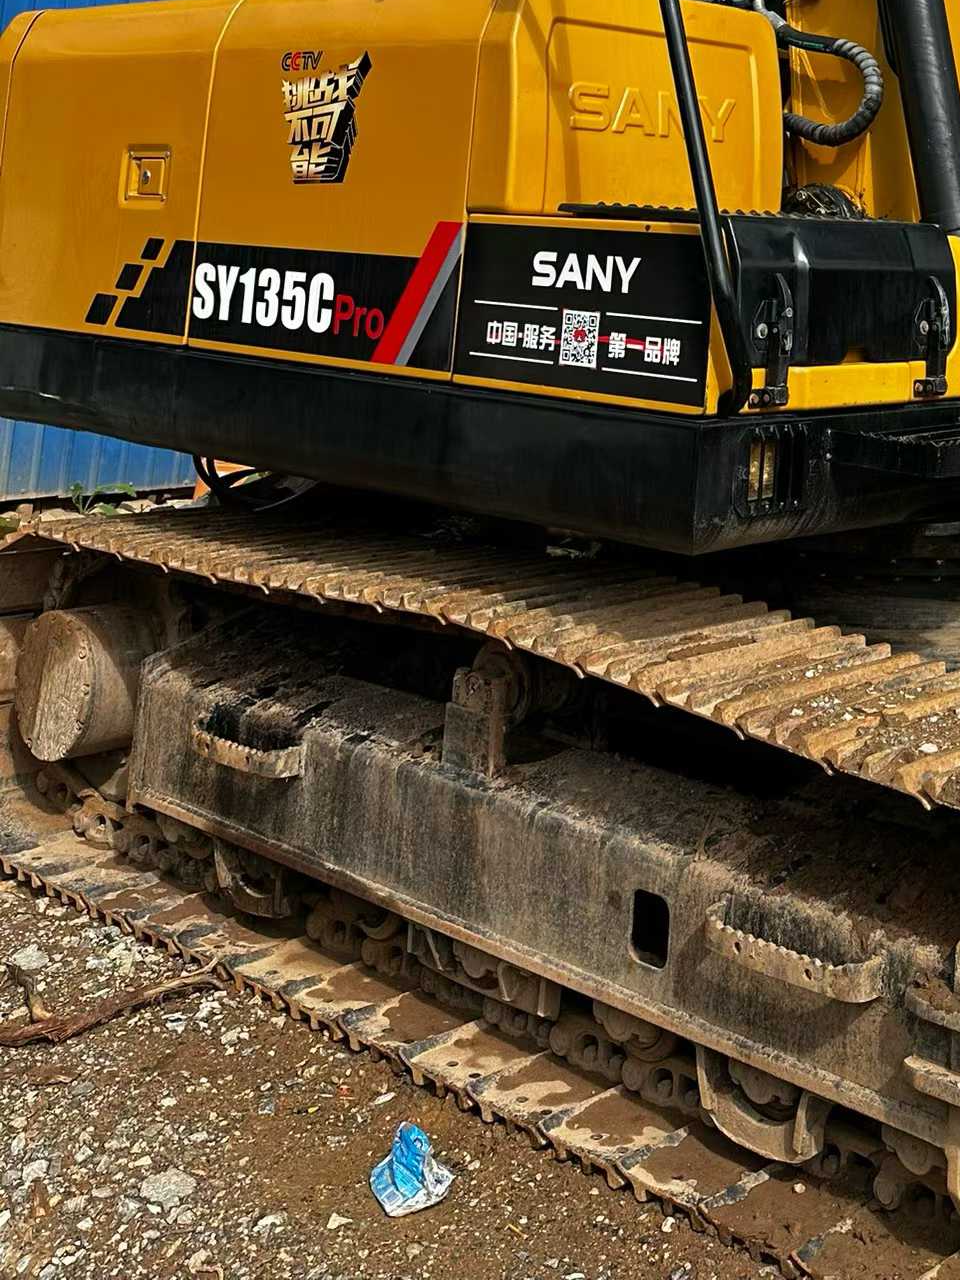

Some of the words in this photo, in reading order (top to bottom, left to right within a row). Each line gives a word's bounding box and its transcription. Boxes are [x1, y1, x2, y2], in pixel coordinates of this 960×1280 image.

[281, 51, 323, 71] CCTV
[282, 56, 364, 111] 挑战
[284, 100, 348, 144] 不可
[289, 142, 332, 178] 能
[531, 251, 642, 294] SANY
[192, 262, 335, 334] SY135C
[332, 294, 385, 340] Pro
[607, 332, 681, 366] 第一品牌
